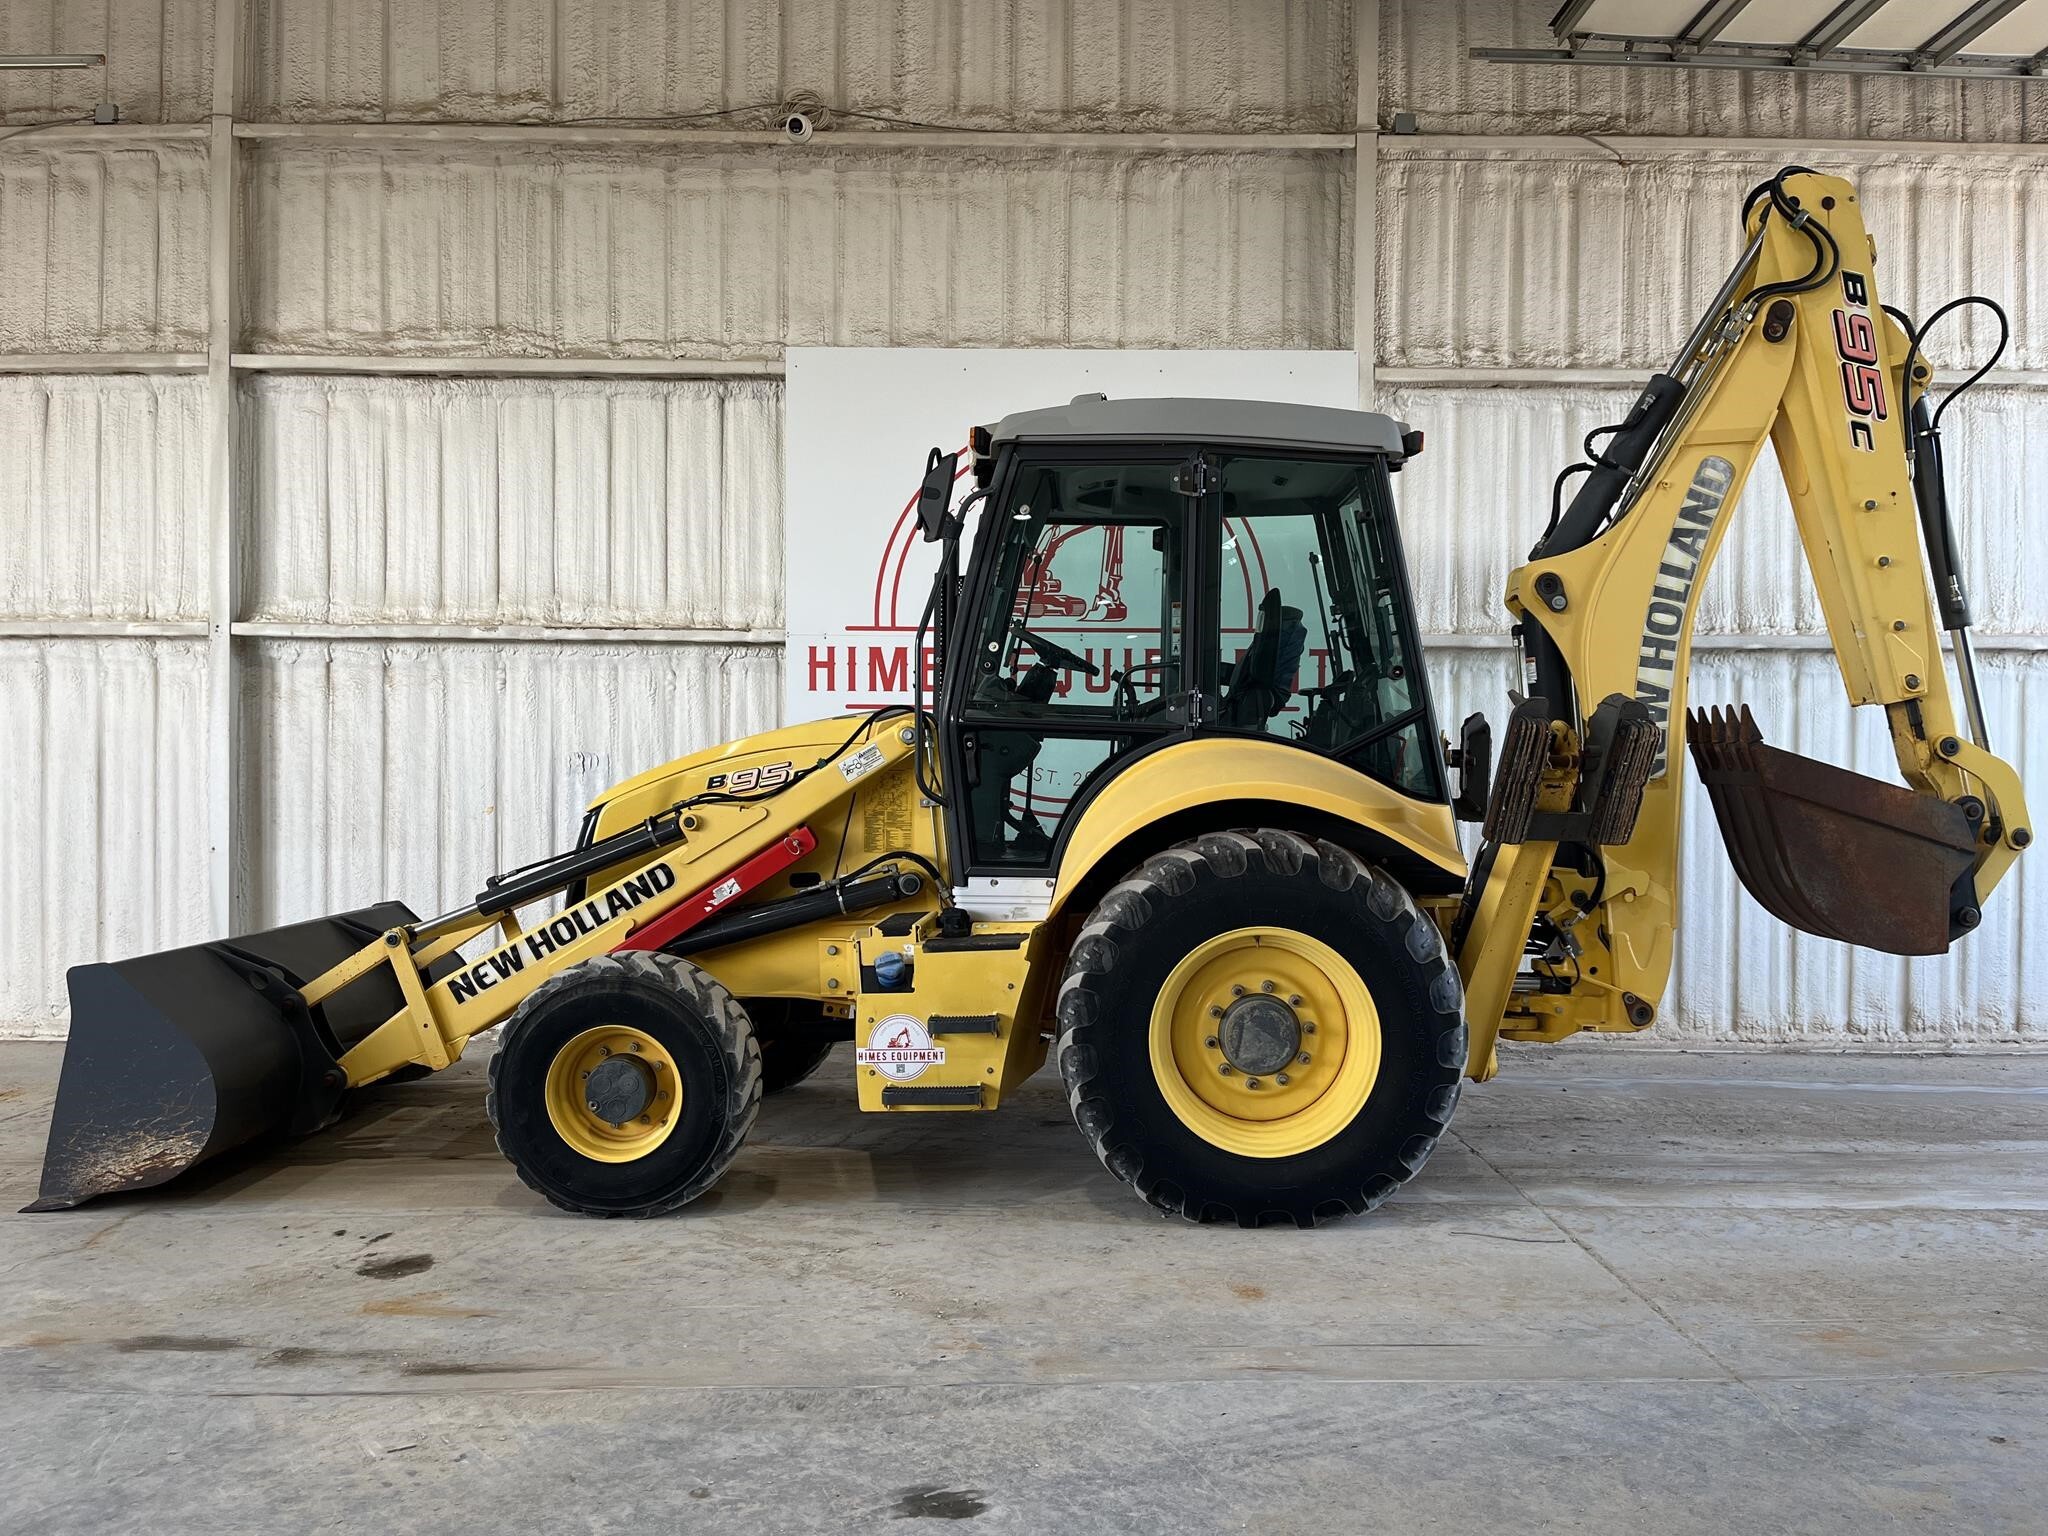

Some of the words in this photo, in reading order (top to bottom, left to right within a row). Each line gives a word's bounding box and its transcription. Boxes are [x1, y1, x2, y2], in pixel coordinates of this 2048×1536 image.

[1831, 269, 1887, 452] B95C
[1638, 455, 1737, 671] HOLLAND
[808, 646, 935, 692] HIME
[447, 944, 525, 1005] NEW
[525, 862, 676, 961] HOLLAND
[858, 1051, 887, 1061] HIMES
[891, 1051, 945, 1061] EQUIPMENT
